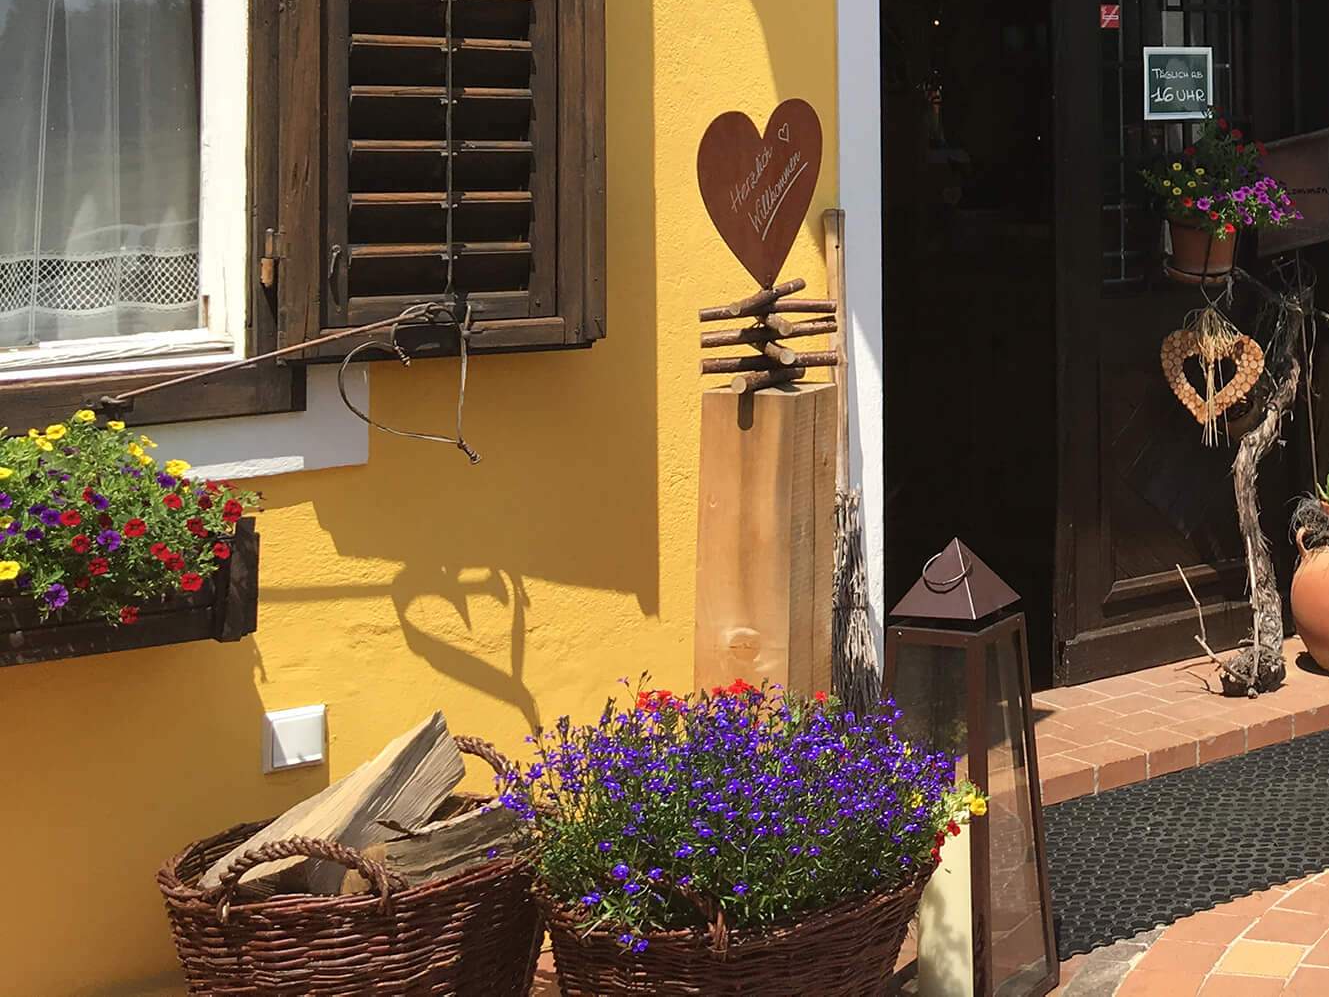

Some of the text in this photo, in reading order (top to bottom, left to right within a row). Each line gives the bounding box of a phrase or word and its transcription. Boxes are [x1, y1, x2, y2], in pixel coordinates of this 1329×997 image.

[1151, 86, 1206, 102] 16 UHR
[730, 146, 774, 213] Herzlich
[748, 151, 801, 232] Willkommen
